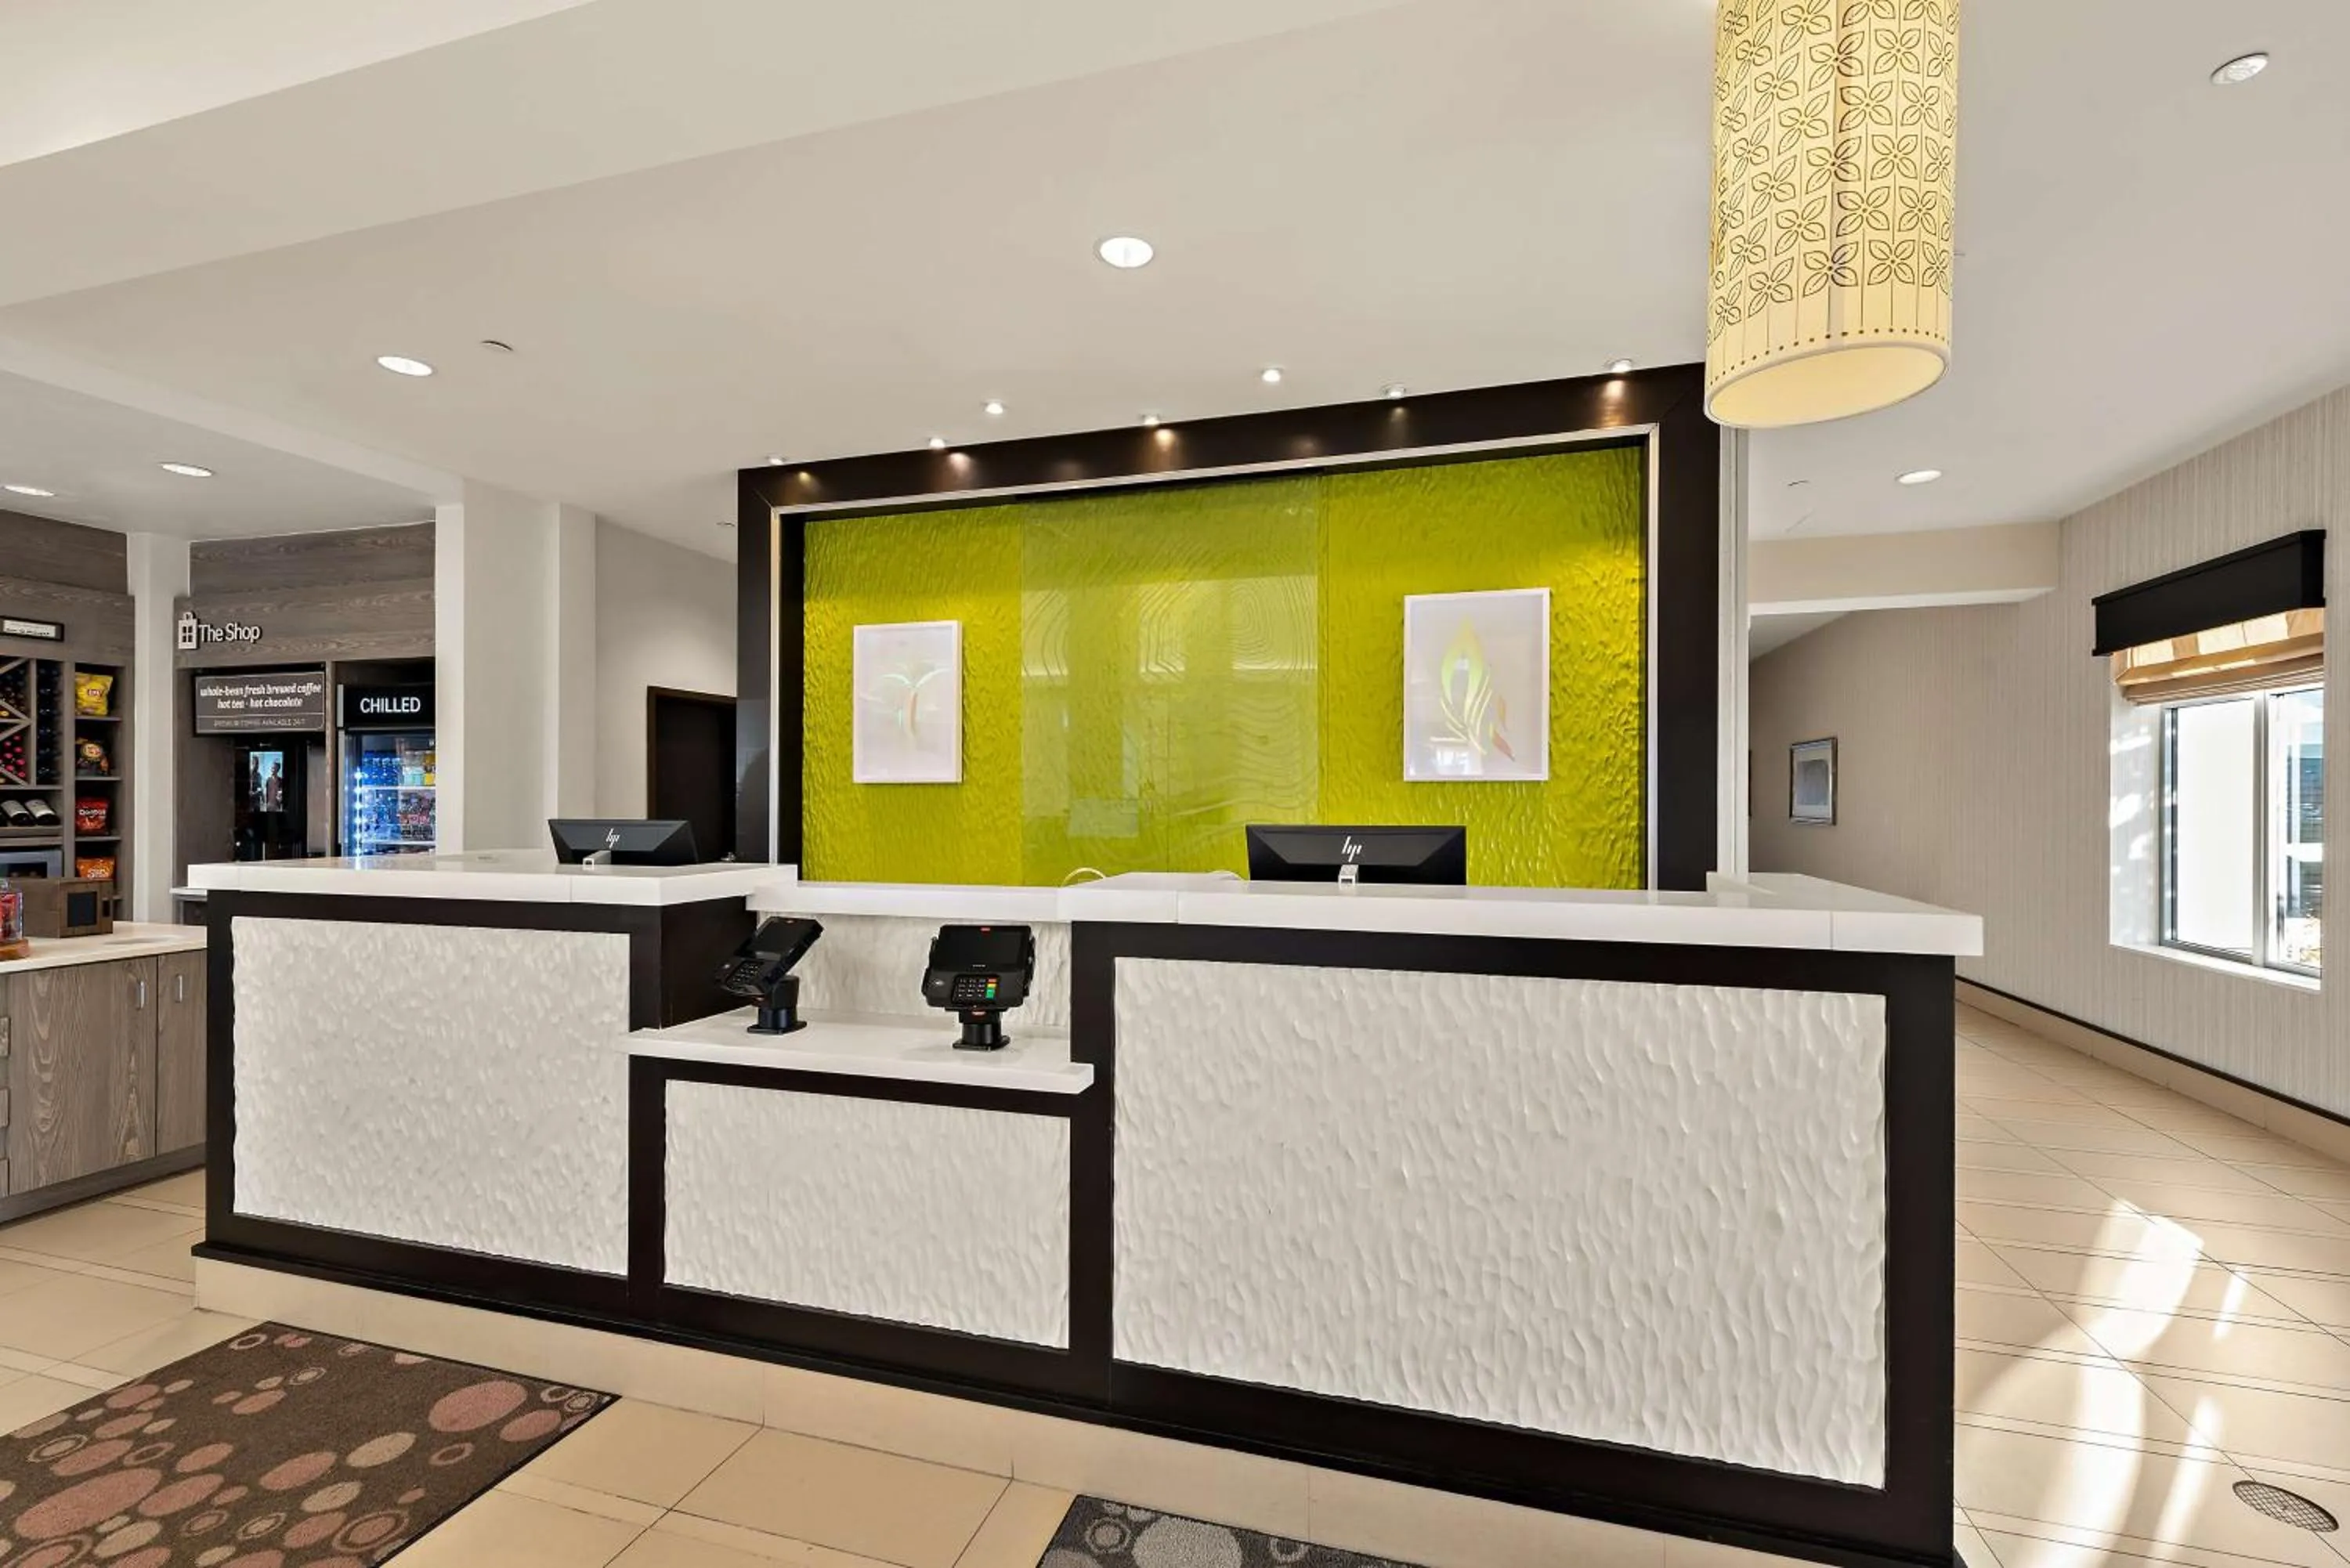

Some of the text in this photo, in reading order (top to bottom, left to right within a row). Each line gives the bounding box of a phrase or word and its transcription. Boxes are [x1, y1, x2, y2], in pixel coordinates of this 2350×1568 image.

[198, 621, 262, 643] The Shop
[244, 683, 266, 698] fresh
[297, 681, 322, 696] coffee
[217, 698, 230, 709] hot
[250, 697, 263, 709] hot
[360, 696, 421, 714] CHILLED
[606, 828, 620, 849] hp
[1341, 835, 1362, 863] hp
